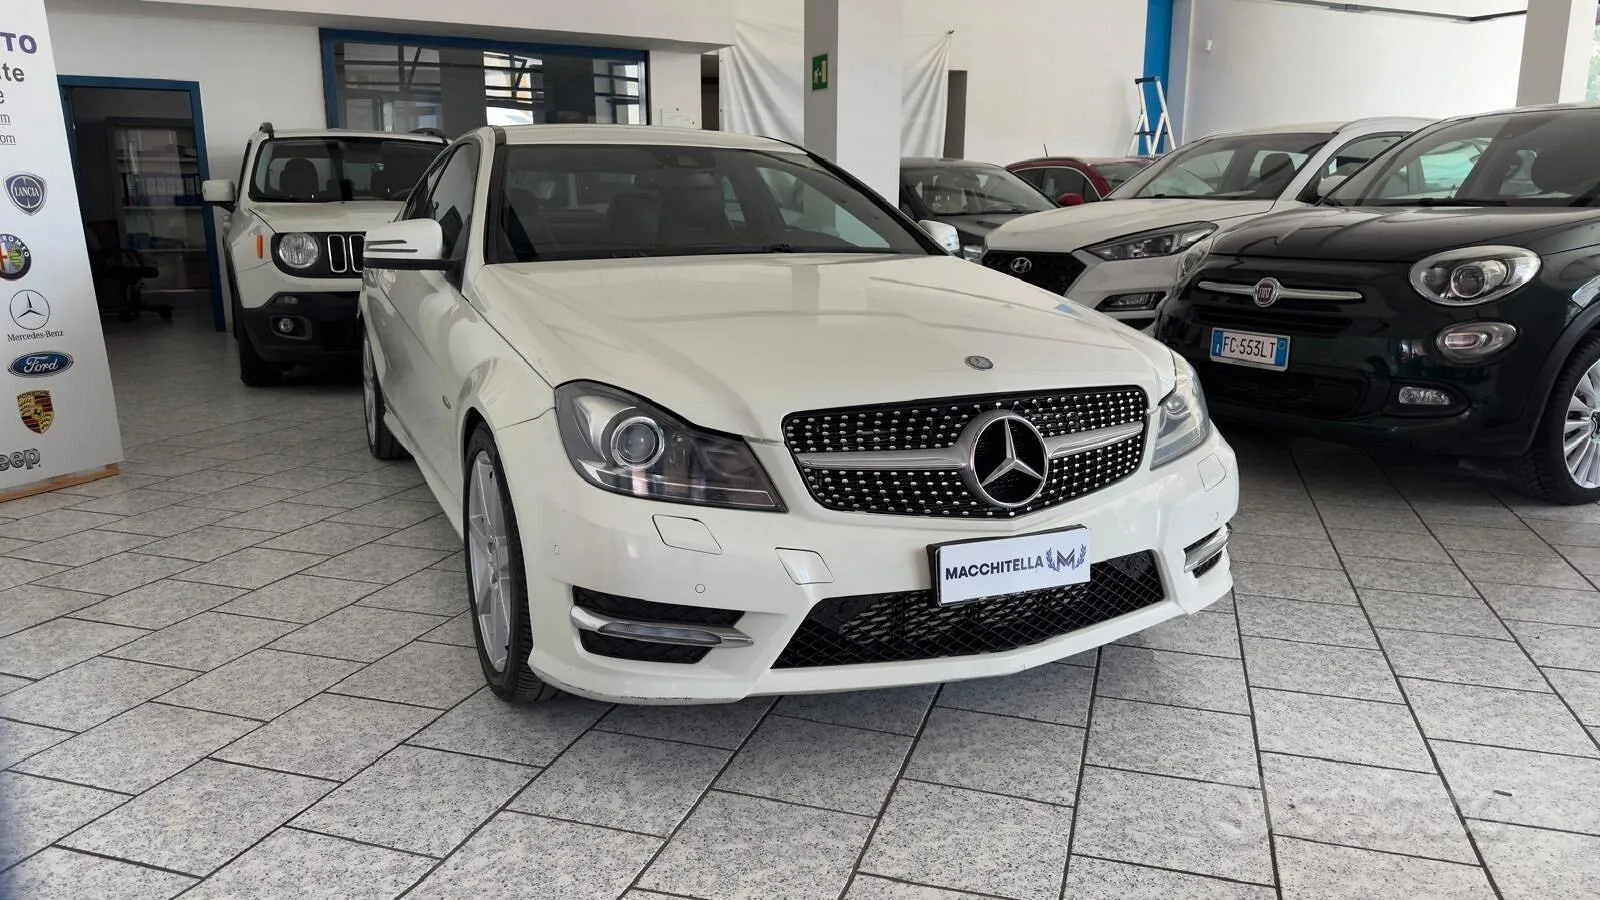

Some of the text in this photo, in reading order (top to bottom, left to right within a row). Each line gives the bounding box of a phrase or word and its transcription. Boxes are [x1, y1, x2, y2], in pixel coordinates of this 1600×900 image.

[0, 31, 37, 54] TO
[0, 63, 25, 82] te
[14, 186, 40, 197] LANCIA
[1258, 287, 1272, 299] FIAT
[7, 330, 65, 342] Mercedes-Benz
[23, 355, 59, 373] Ford
[945, 555, 1044, 580] MACCHITELLA
